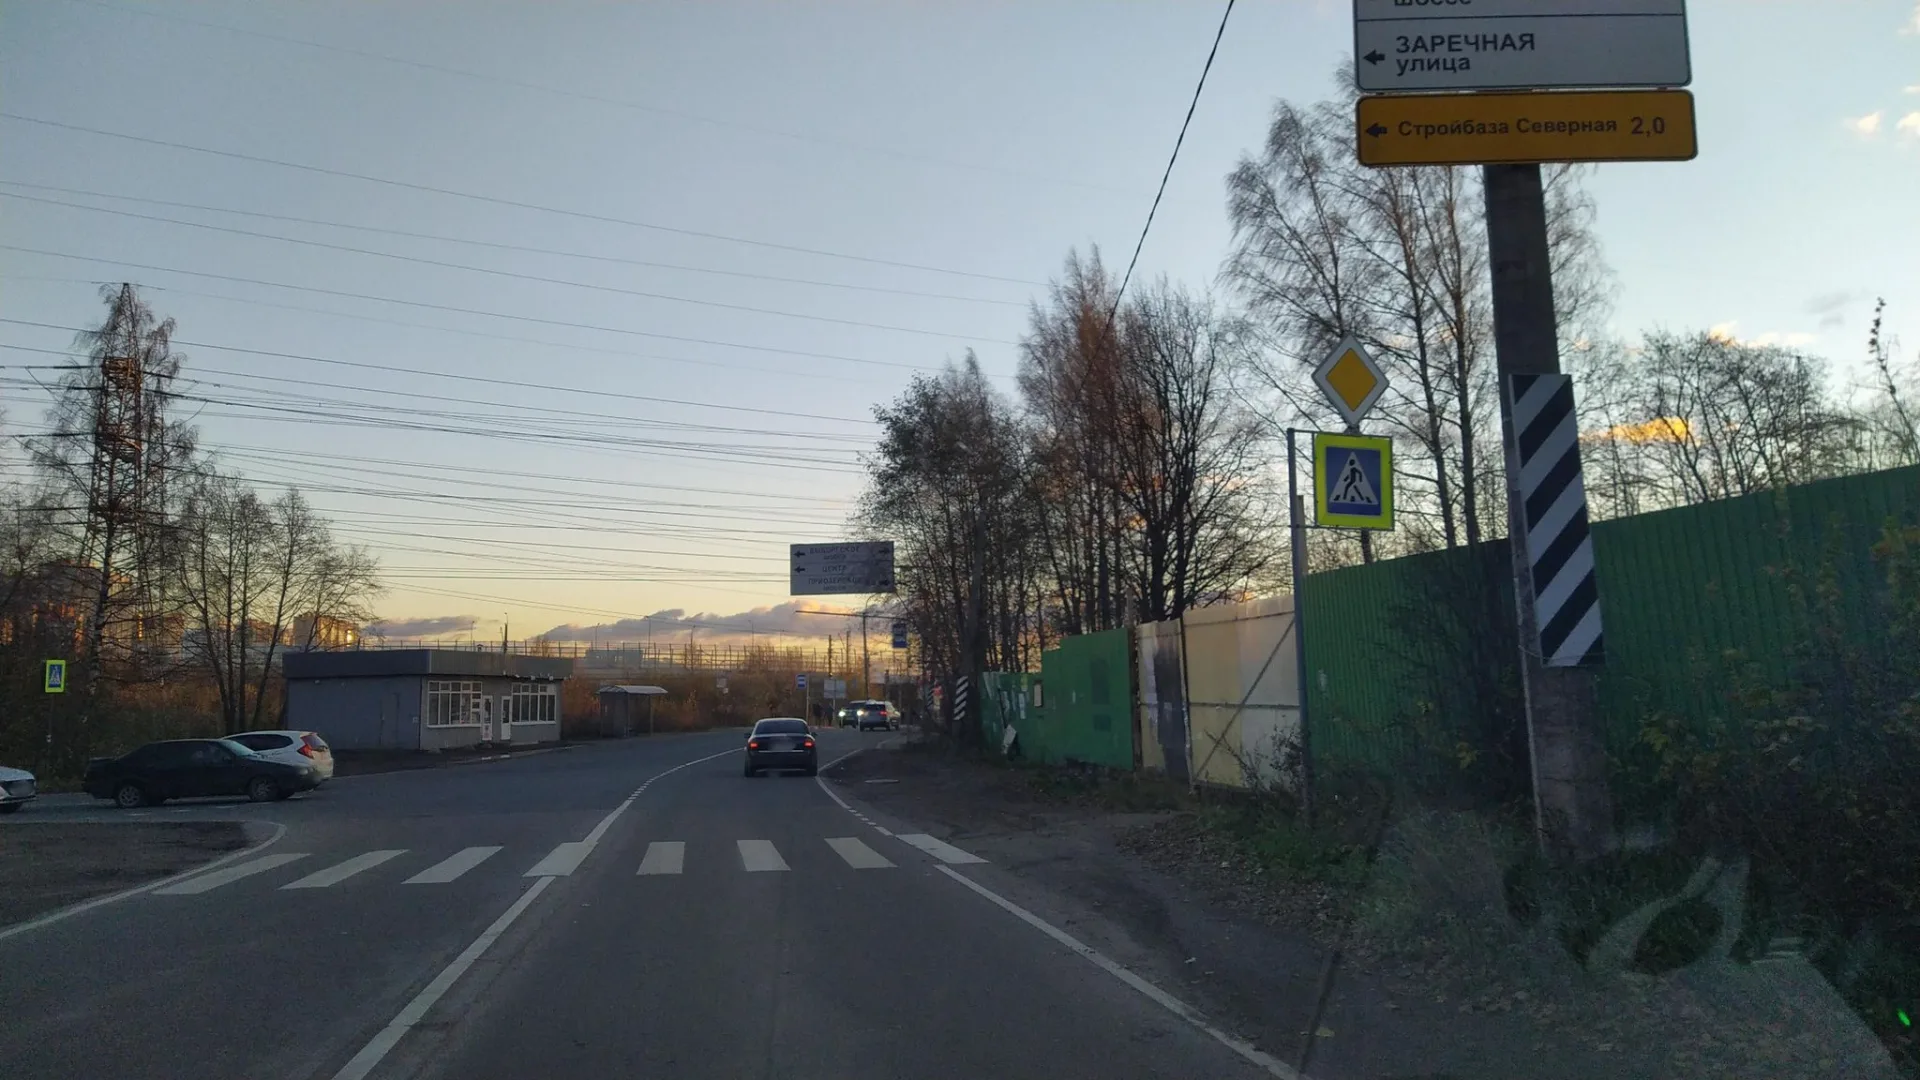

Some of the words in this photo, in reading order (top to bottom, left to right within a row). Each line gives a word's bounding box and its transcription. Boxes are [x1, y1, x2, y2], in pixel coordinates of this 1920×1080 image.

[1396, 33, 1535, 53] ЗАРЕЧНАЯ
[1396, 57, 1471, 77] улица
[1398, 119, 1509, 139] Стройбаза
[1516, 117, 1618, 136] Северная
[1631, 116, 1666, 136] 2,0
